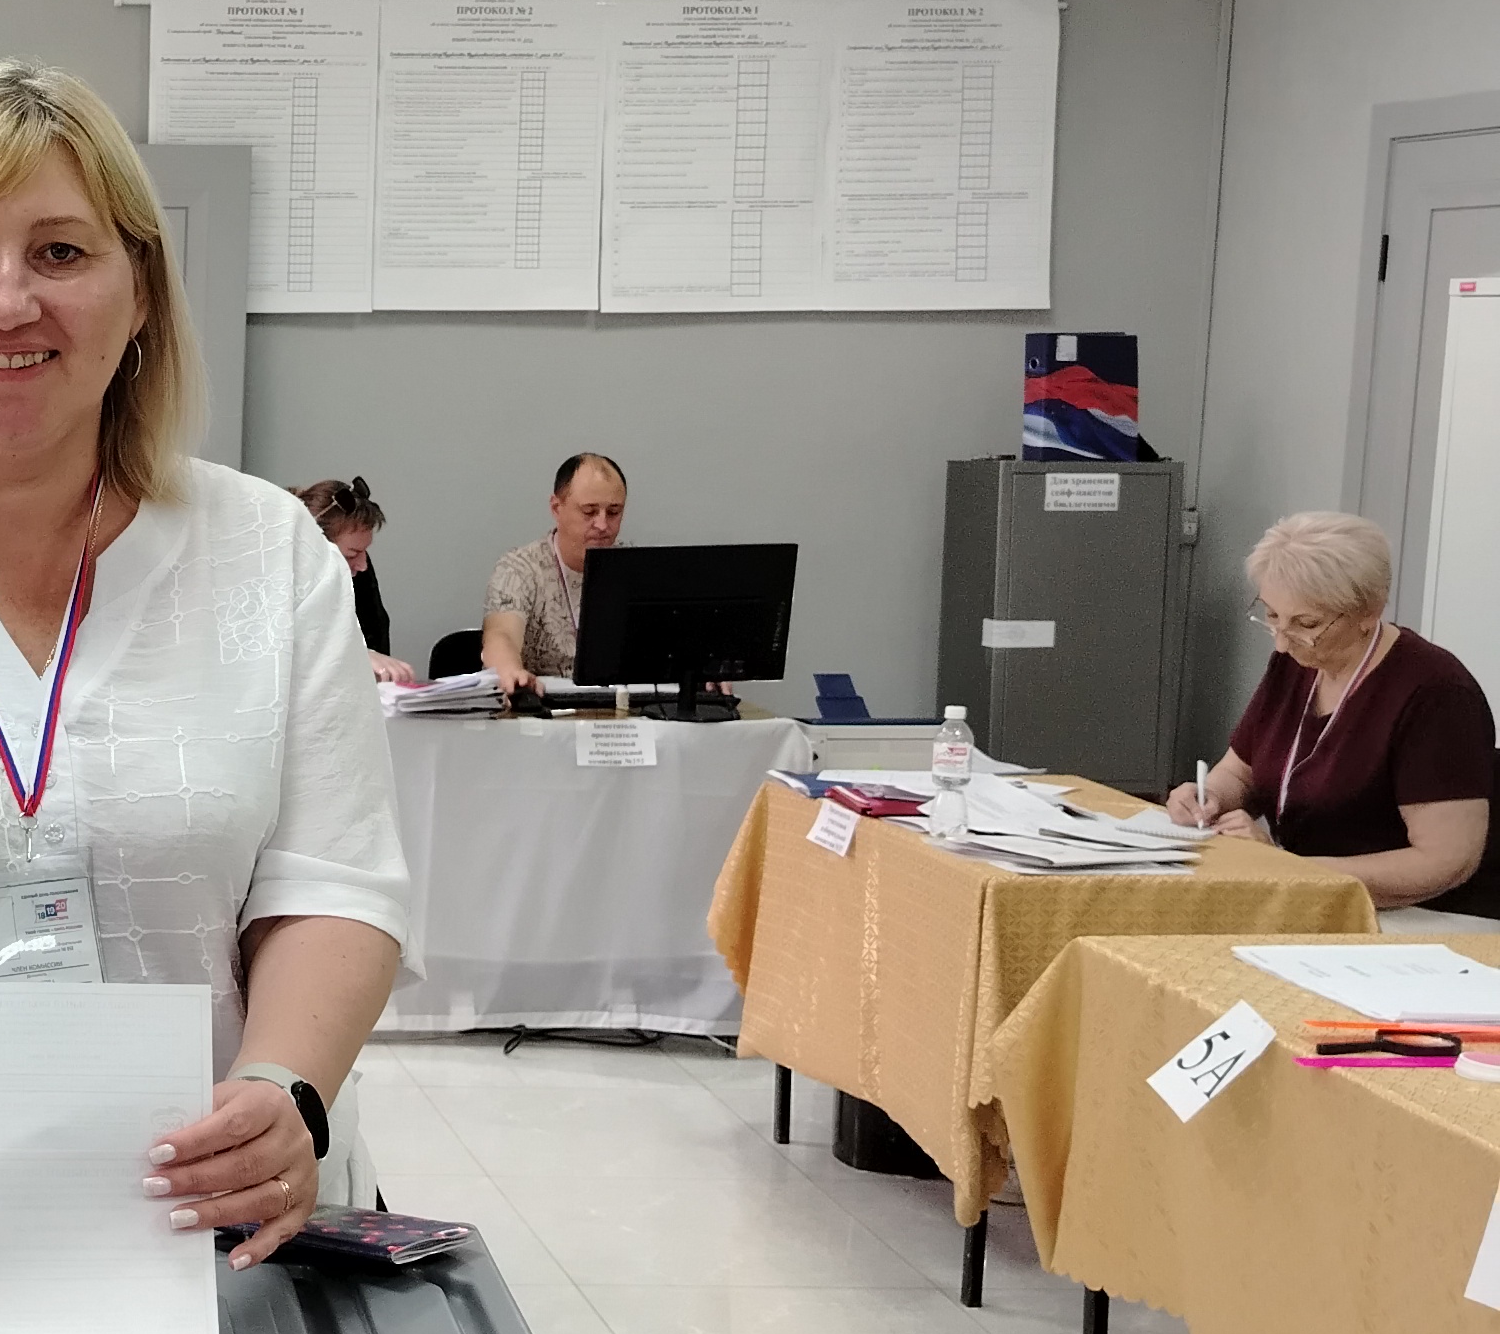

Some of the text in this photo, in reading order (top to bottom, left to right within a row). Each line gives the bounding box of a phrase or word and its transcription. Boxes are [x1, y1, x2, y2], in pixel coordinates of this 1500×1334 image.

[227, 6, 285, 16] ПРОТОКОЛ
[300, 7, 305, 16] 1
[456, 6, 514, 15] ПРОТОКОЛ
[528, 6, 533, 15] 2
[682, 6, 740, 15] ПРОТОКОЛ
[754, 6, 758, 15] 1
[907, 7, 964, 17] ПРОТОКОЛ
[979, 7, 984, 16] 2
[37, 911, 46, 920] 18
[56, 901, 66, 910] 20
